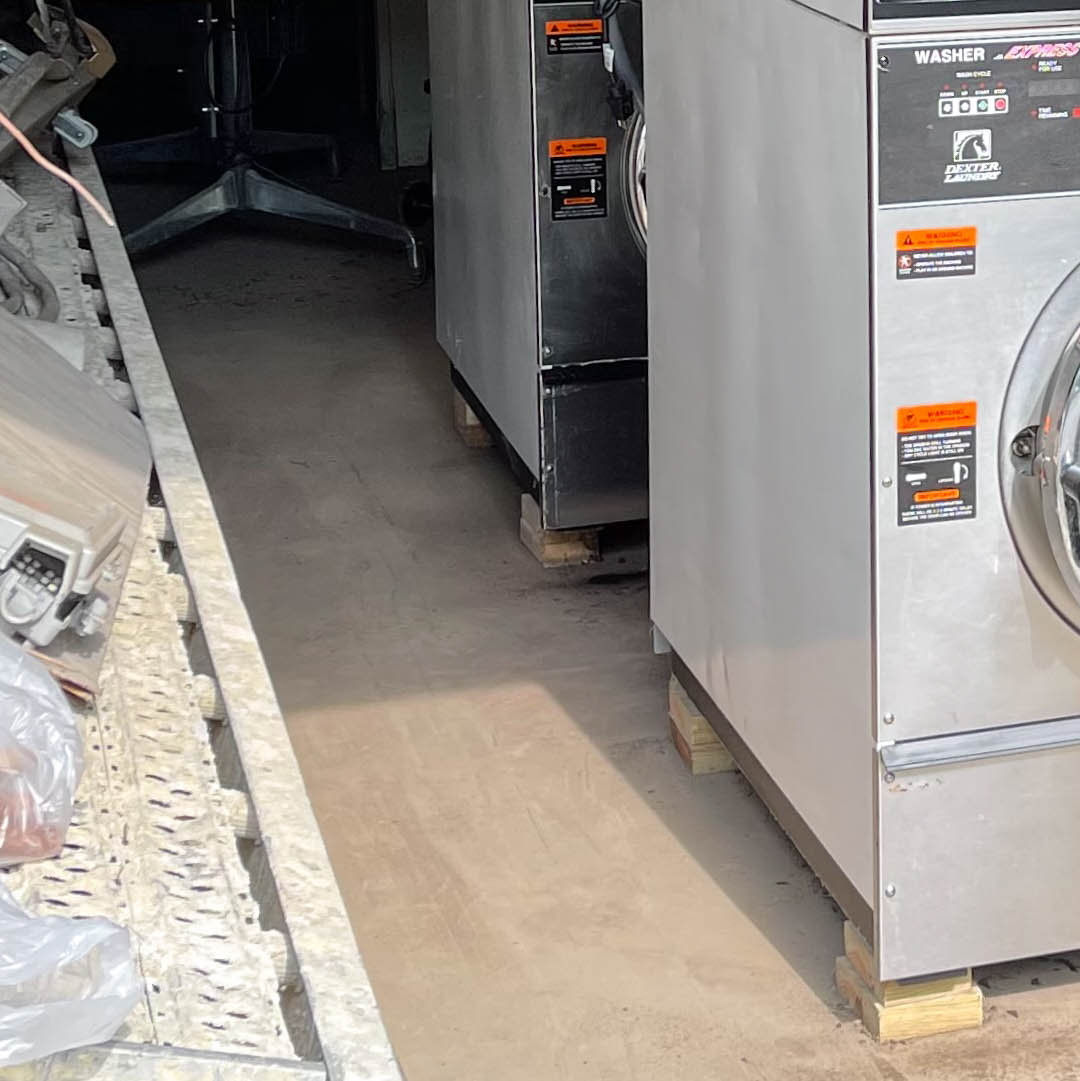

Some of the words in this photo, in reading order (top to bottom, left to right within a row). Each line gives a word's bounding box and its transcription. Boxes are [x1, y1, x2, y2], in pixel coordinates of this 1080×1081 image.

[914, 47, 985, 64] WASHER
[944, 162, 1000, 174] DEXTER
[943, 170, 1002, 183] LAUNDRY
